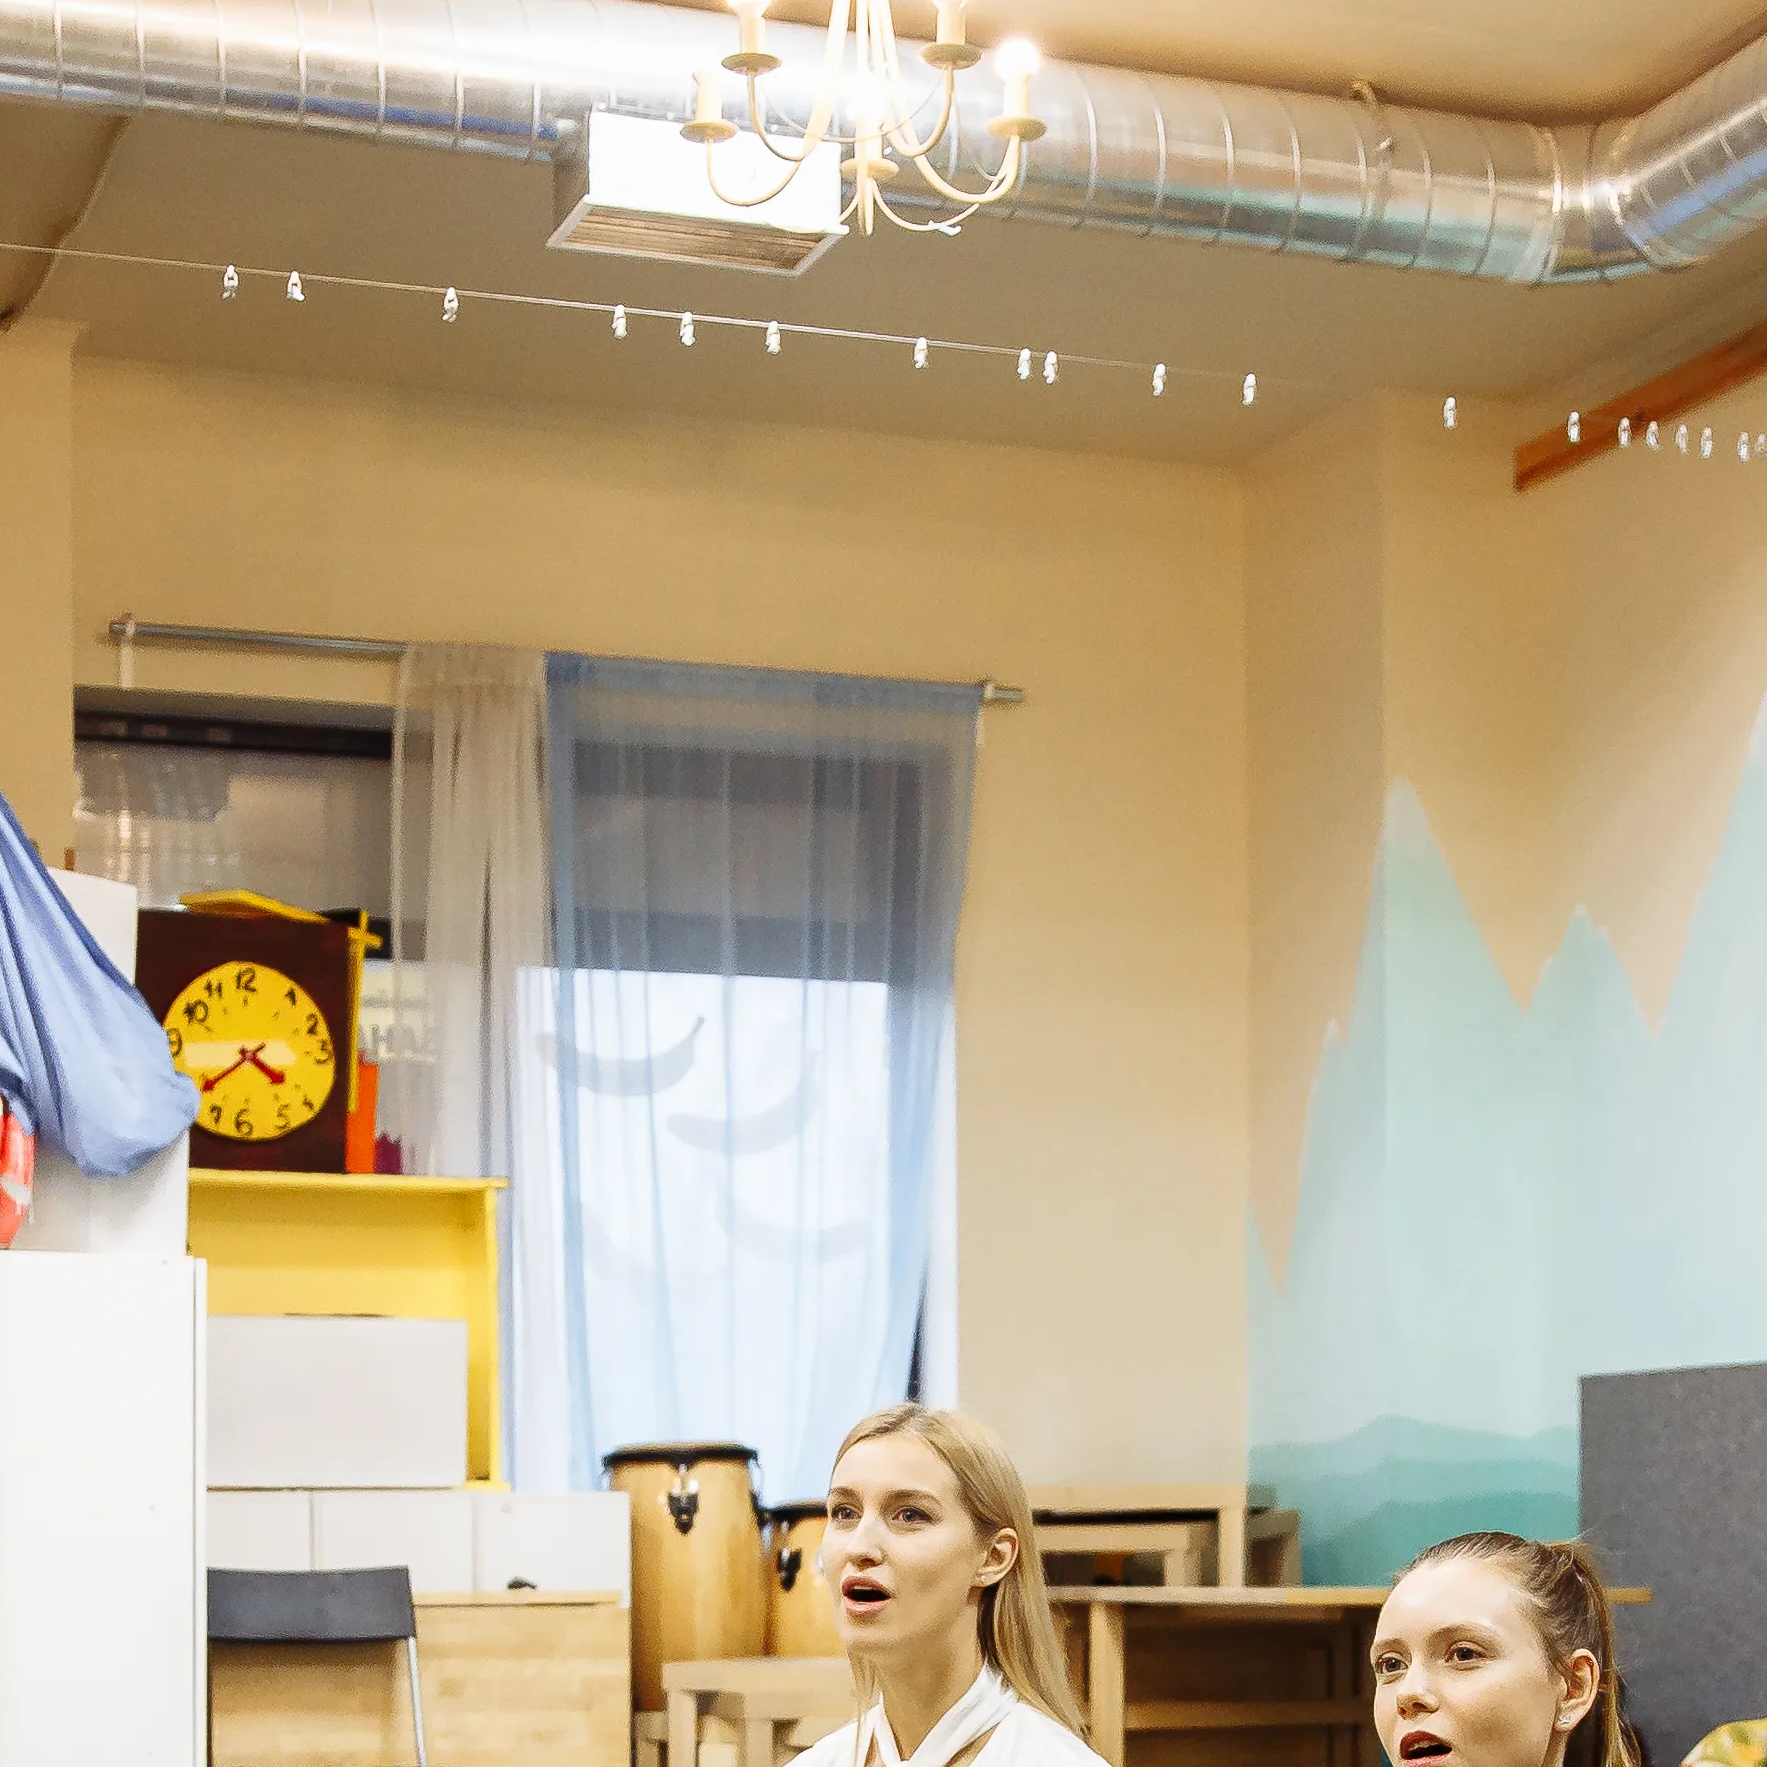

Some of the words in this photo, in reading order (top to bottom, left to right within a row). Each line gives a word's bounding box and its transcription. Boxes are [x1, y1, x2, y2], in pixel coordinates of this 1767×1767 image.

[203, 979, 223, 999] 11
[235, 967, 257, 993] 12
[183, 999, 209, 1024] 10
[306, 1013, 319, 1036] 2
[314, 1039, 332, 1065] 3
[234, 1107, 254, 1137] 6
[274, 1103, 291, 1131] 5
